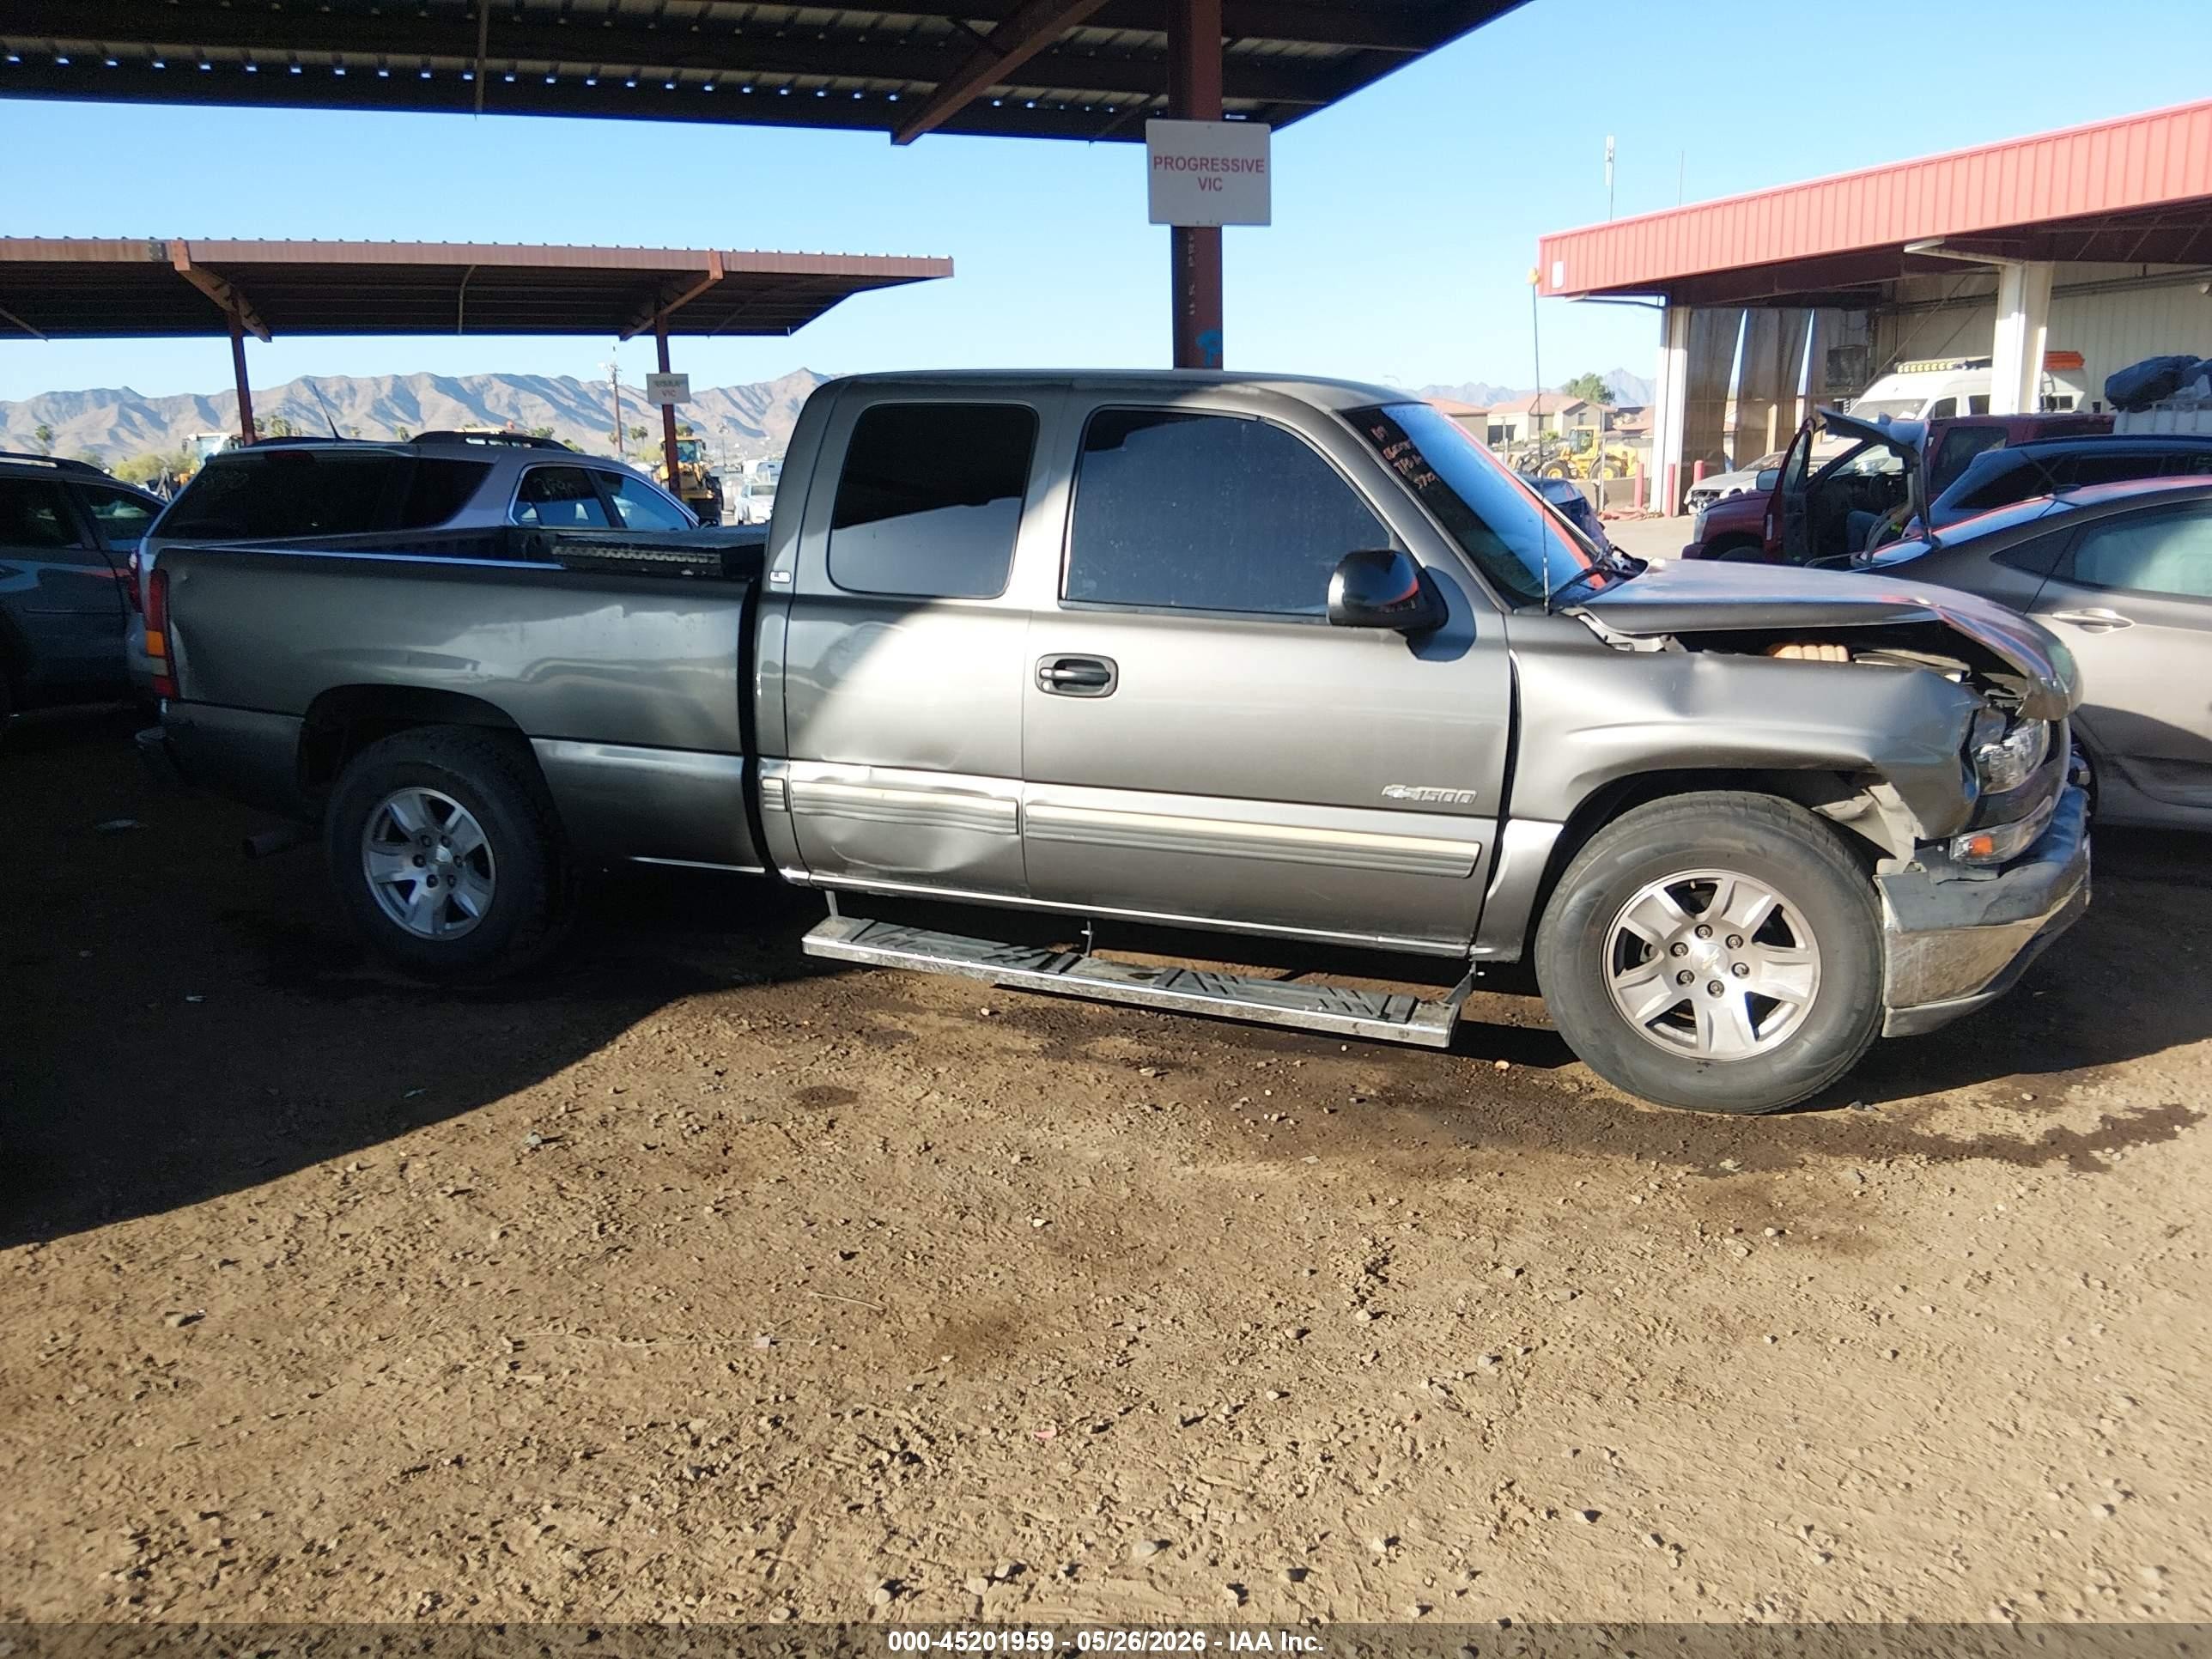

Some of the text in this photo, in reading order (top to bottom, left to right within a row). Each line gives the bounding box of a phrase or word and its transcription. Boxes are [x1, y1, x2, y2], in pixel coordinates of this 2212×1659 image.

[1153, 156, 1265, 173] PROGRESSIVE
[1198, 176, 1223, 191] VIC
[1414, 786, 1477, 804] 1500
